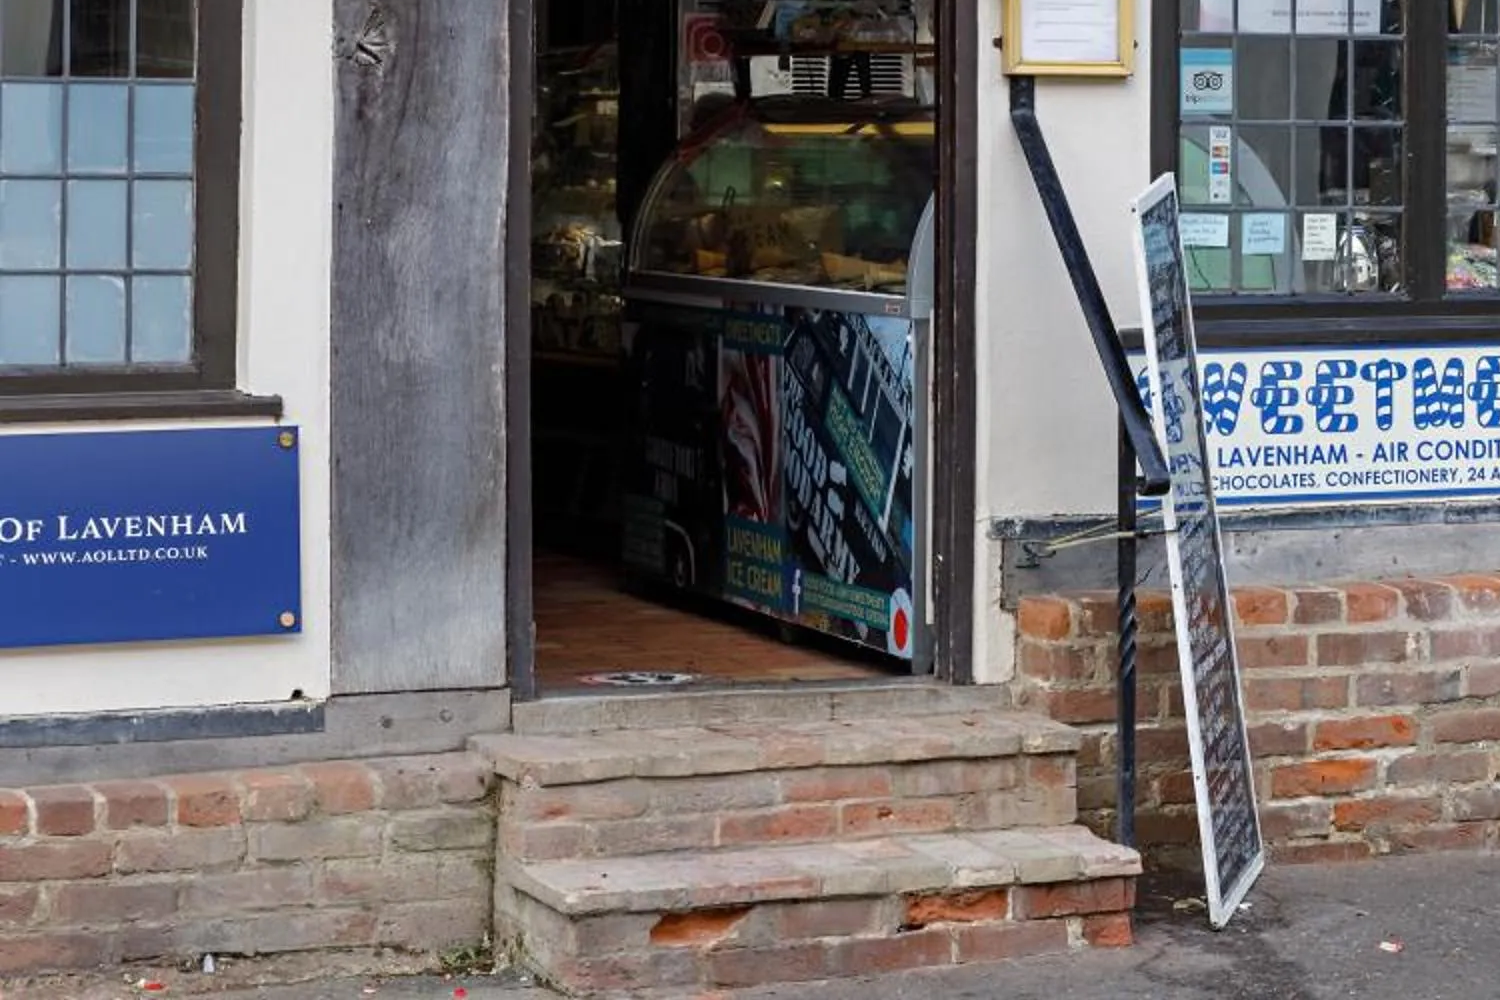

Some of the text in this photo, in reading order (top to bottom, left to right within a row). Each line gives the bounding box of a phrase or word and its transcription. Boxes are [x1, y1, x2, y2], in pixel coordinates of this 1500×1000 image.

[1217, 441, 1348, 468] LAVENHAM
[1372, 440, 1408, 463] AIR
[1467, 466, 1486, 481] 24
[57, 512, 249, 541] LAVENHAM
[23, 545, 209, 566] WWW.AOLLTD.CO.UK
